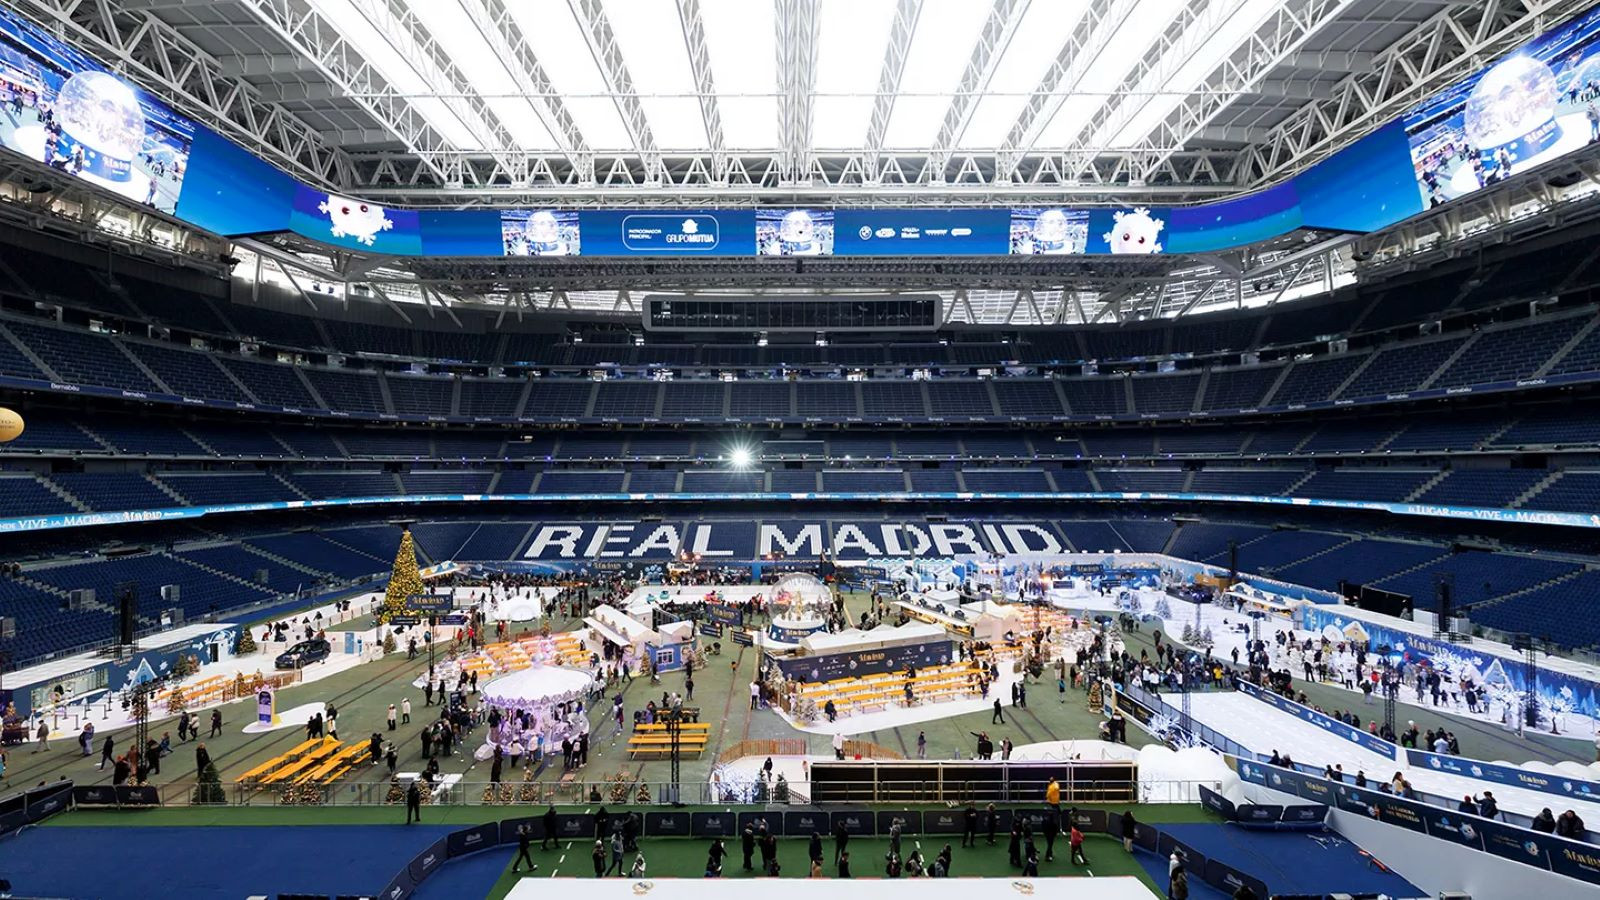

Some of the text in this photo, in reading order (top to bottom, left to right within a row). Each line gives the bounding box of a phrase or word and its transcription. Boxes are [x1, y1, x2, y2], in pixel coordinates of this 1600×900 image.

[1474, 510, 1501, 519] VIVE
[18, 518, 48, 529] VIVE
[524, 523, 1062, 559] REAL MADRID
